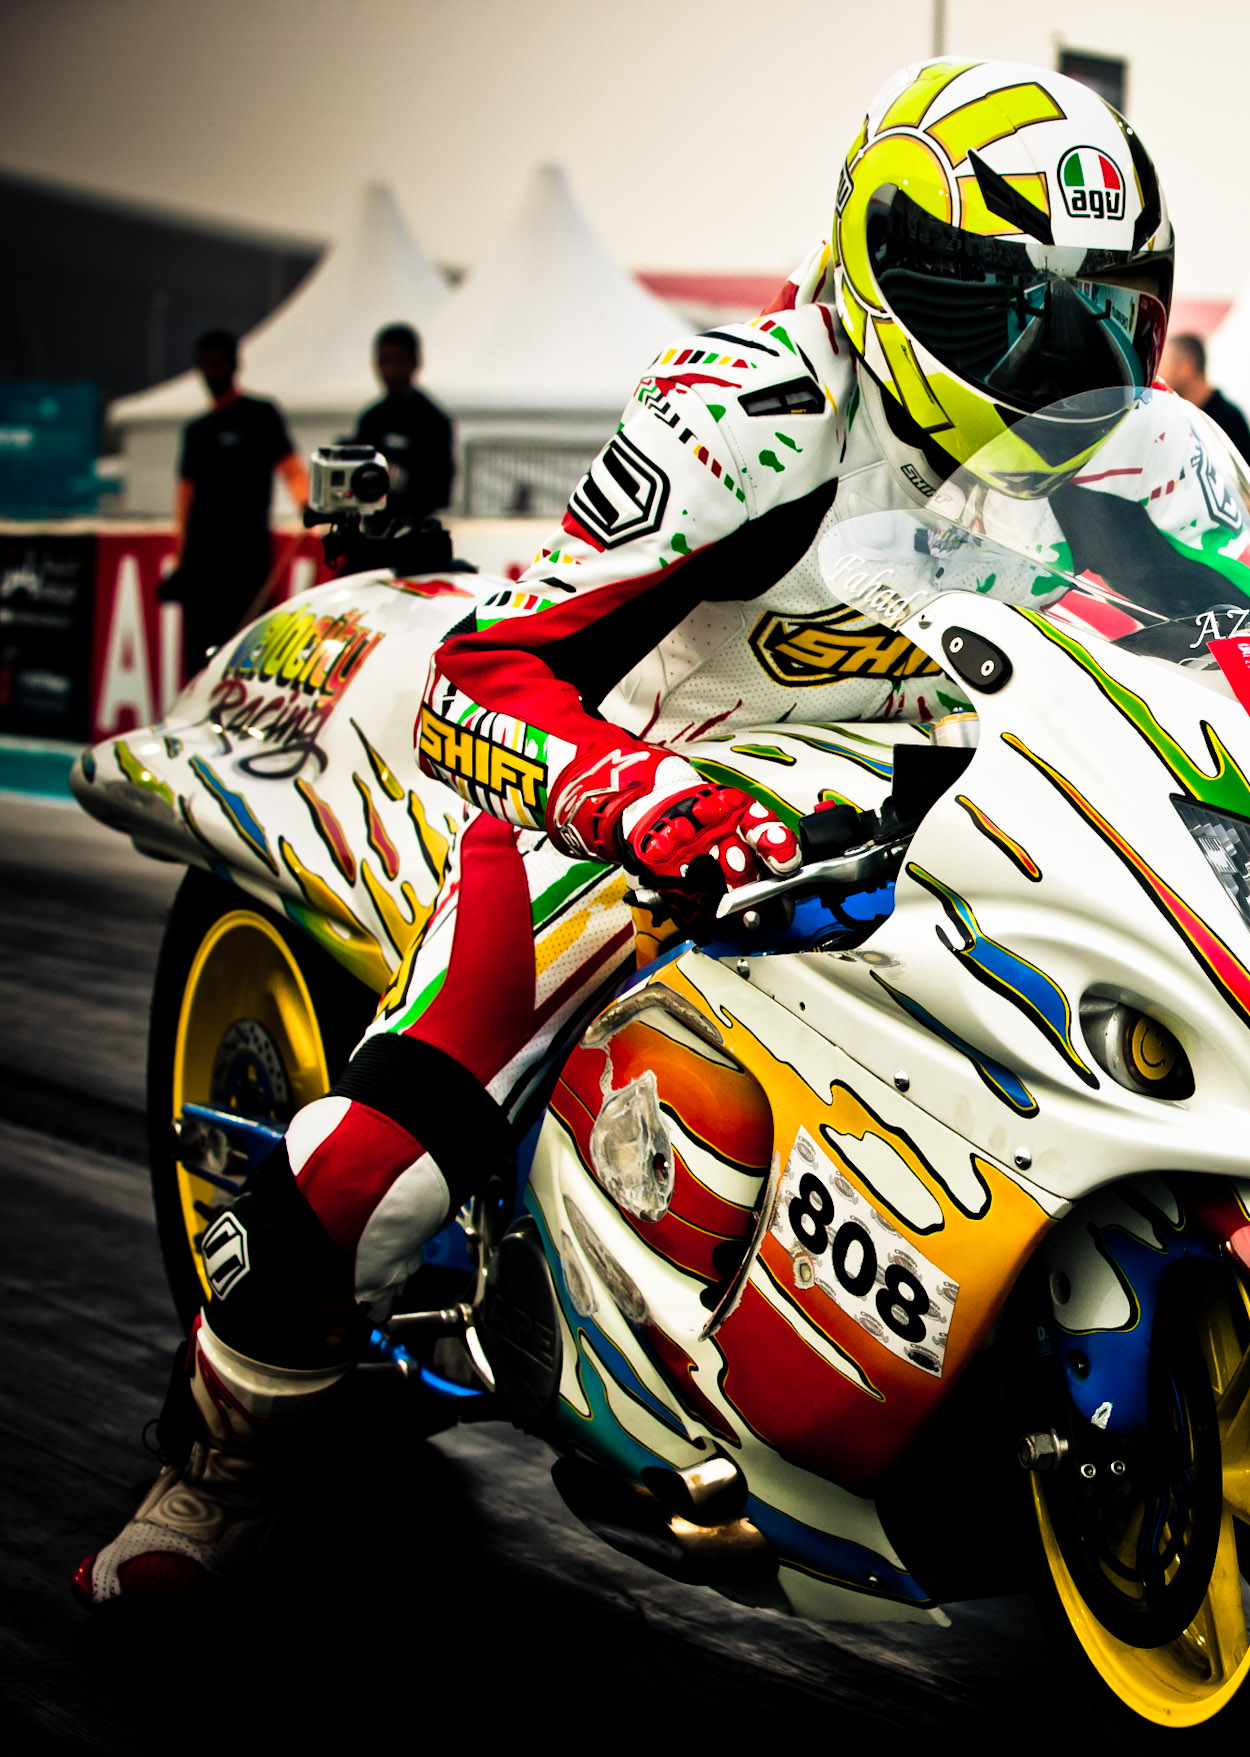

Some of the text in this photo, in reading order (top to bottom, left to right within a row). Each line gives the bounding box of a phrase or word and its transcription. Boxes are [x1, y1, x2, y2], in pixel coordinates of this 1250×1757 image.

[1071, 188, 1120, 220] agv
[420, 706, 545, 807] SHIFT
[788, 1172, 930, 1343] 808
